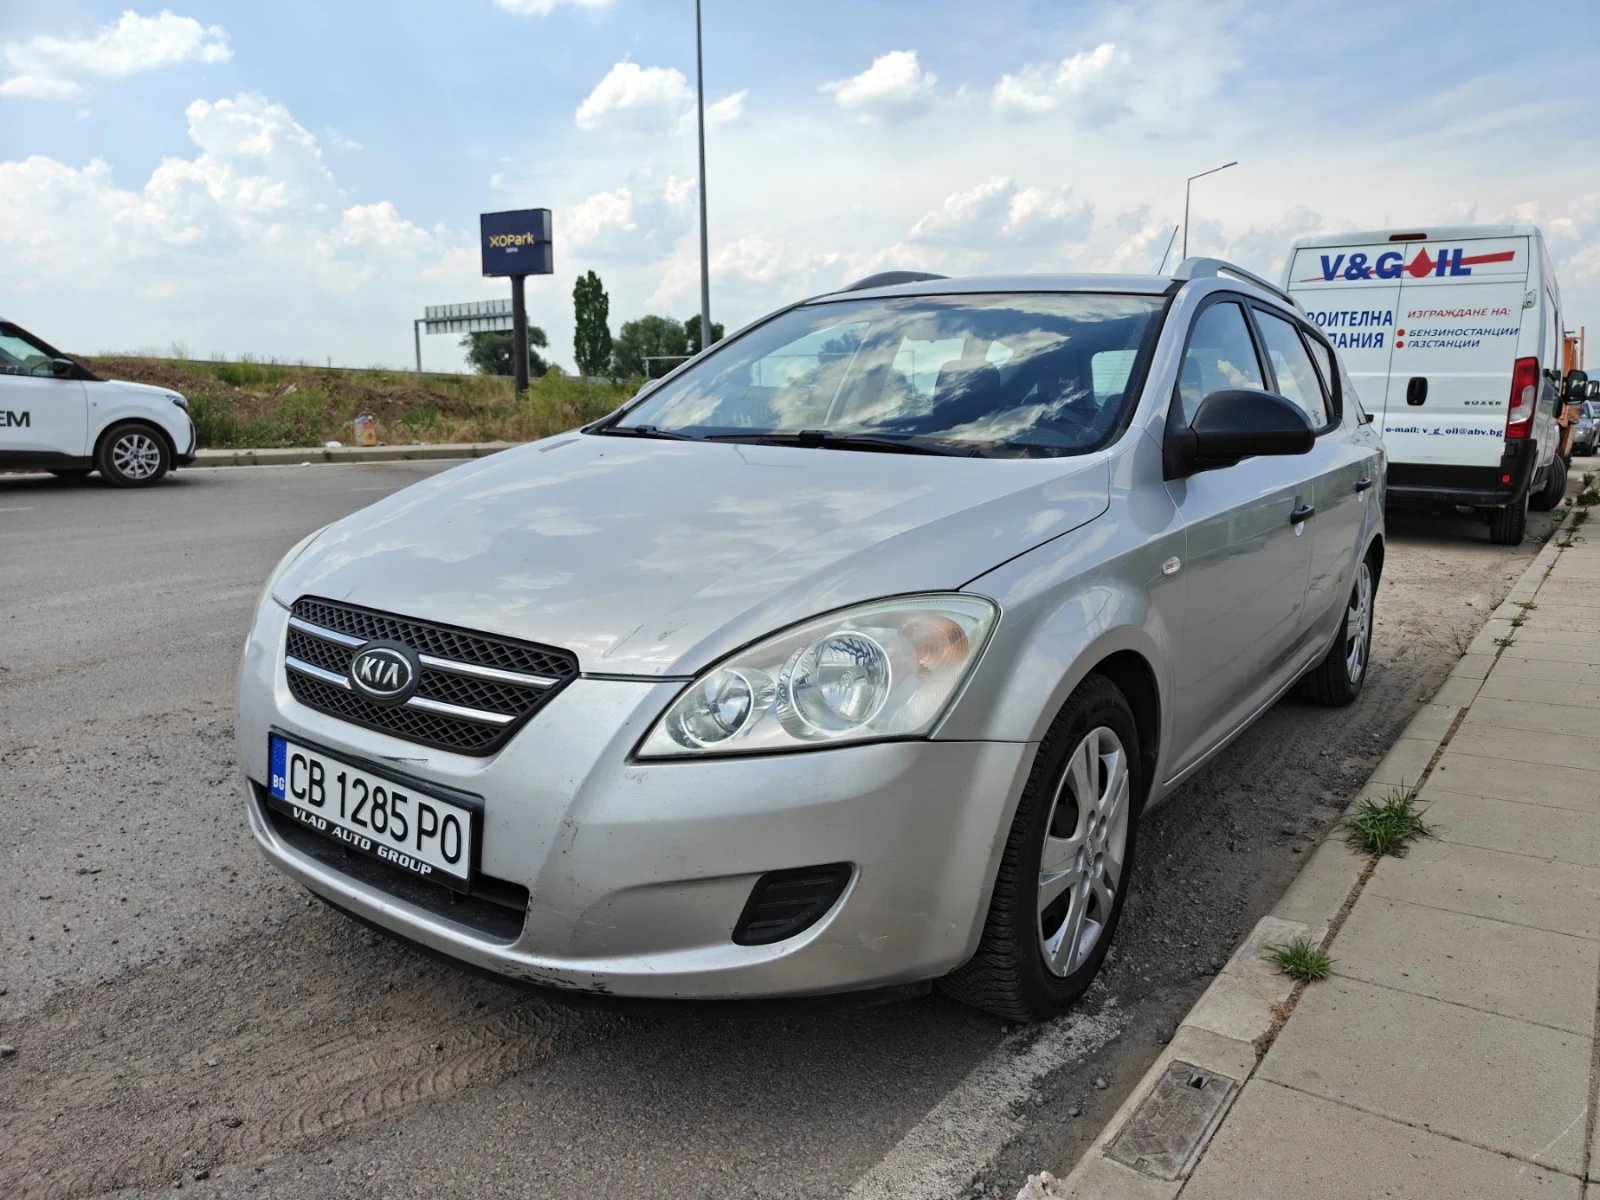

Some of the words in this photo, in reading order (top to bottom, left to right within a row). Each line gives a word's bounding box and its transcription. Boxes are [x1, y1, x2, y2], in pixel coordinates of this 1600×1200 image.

[489, 231, 535, 248] XOPark
[1407, 308, 1489, 319] ИЗГРАЖДАНЕ
[1490, 307, 1511, 317] НА:
[1408, 327, 1519, 337] БЕНЗИНОСТАНЦИИ
[1407, 339, 1481, 349] ГАЗСТАНЦИИ
[1385, 426, 1420, 434] e-mail:
[1421, 427, 1503, 437] v_g_oil@abv.bg
[360, 656, 399, 689] KIA
[272, 774, 285, 791] BG
[337, 771, 409, 843] 1285
[292, 807, 327, 831] VLAD
[332, 826, 371, 851] AUTO
[377, 846, 433, 875] GROUP
